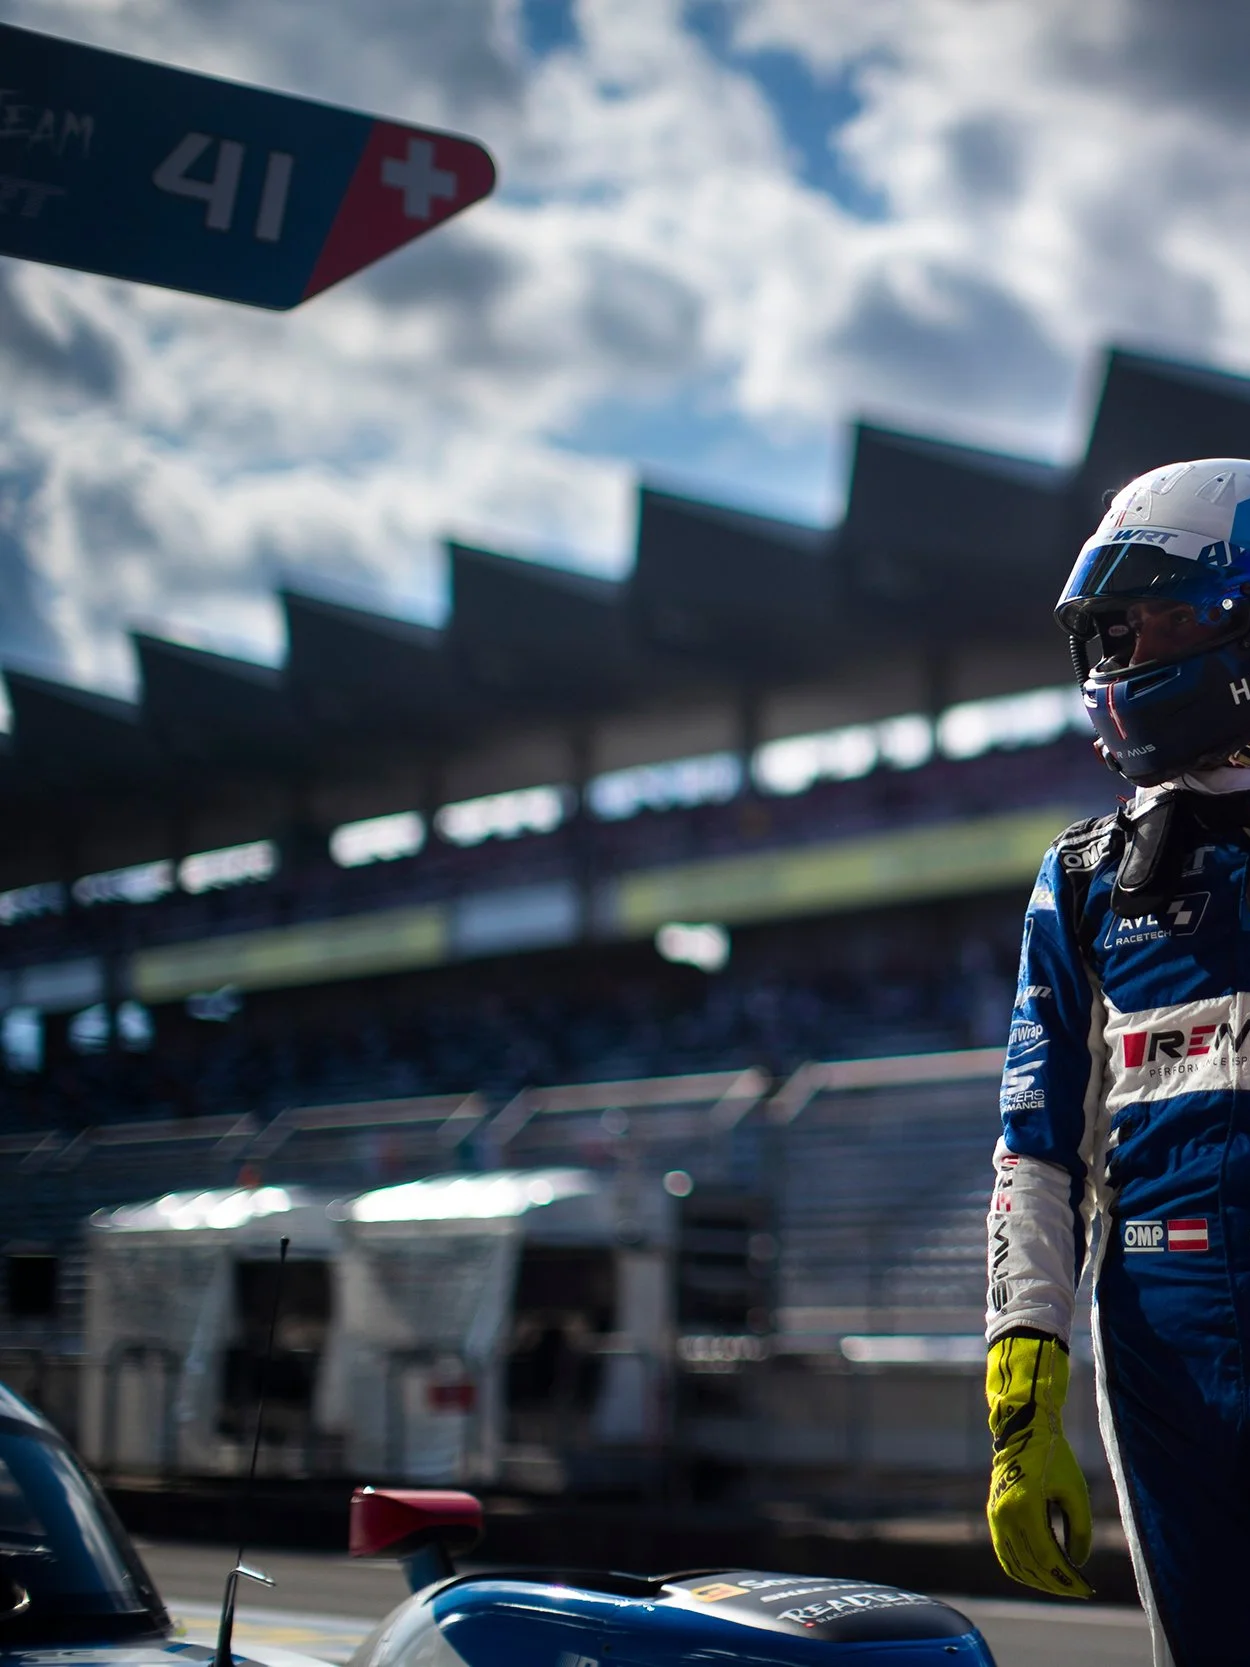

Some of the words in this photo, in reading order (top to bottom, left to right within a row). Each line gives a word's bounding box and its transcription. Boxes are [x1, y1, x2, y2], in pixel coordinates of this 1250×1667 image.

[0, 97, 95, 159] EAM
[152, 131, 294, 242] 41
[1112, 529, 1178, 545] WRT
[1063, 836, 1110, 867] OMP
[1115, 929, 1172, 947] RACETECH
[1124, 1224, 1164, 1247] OMP
